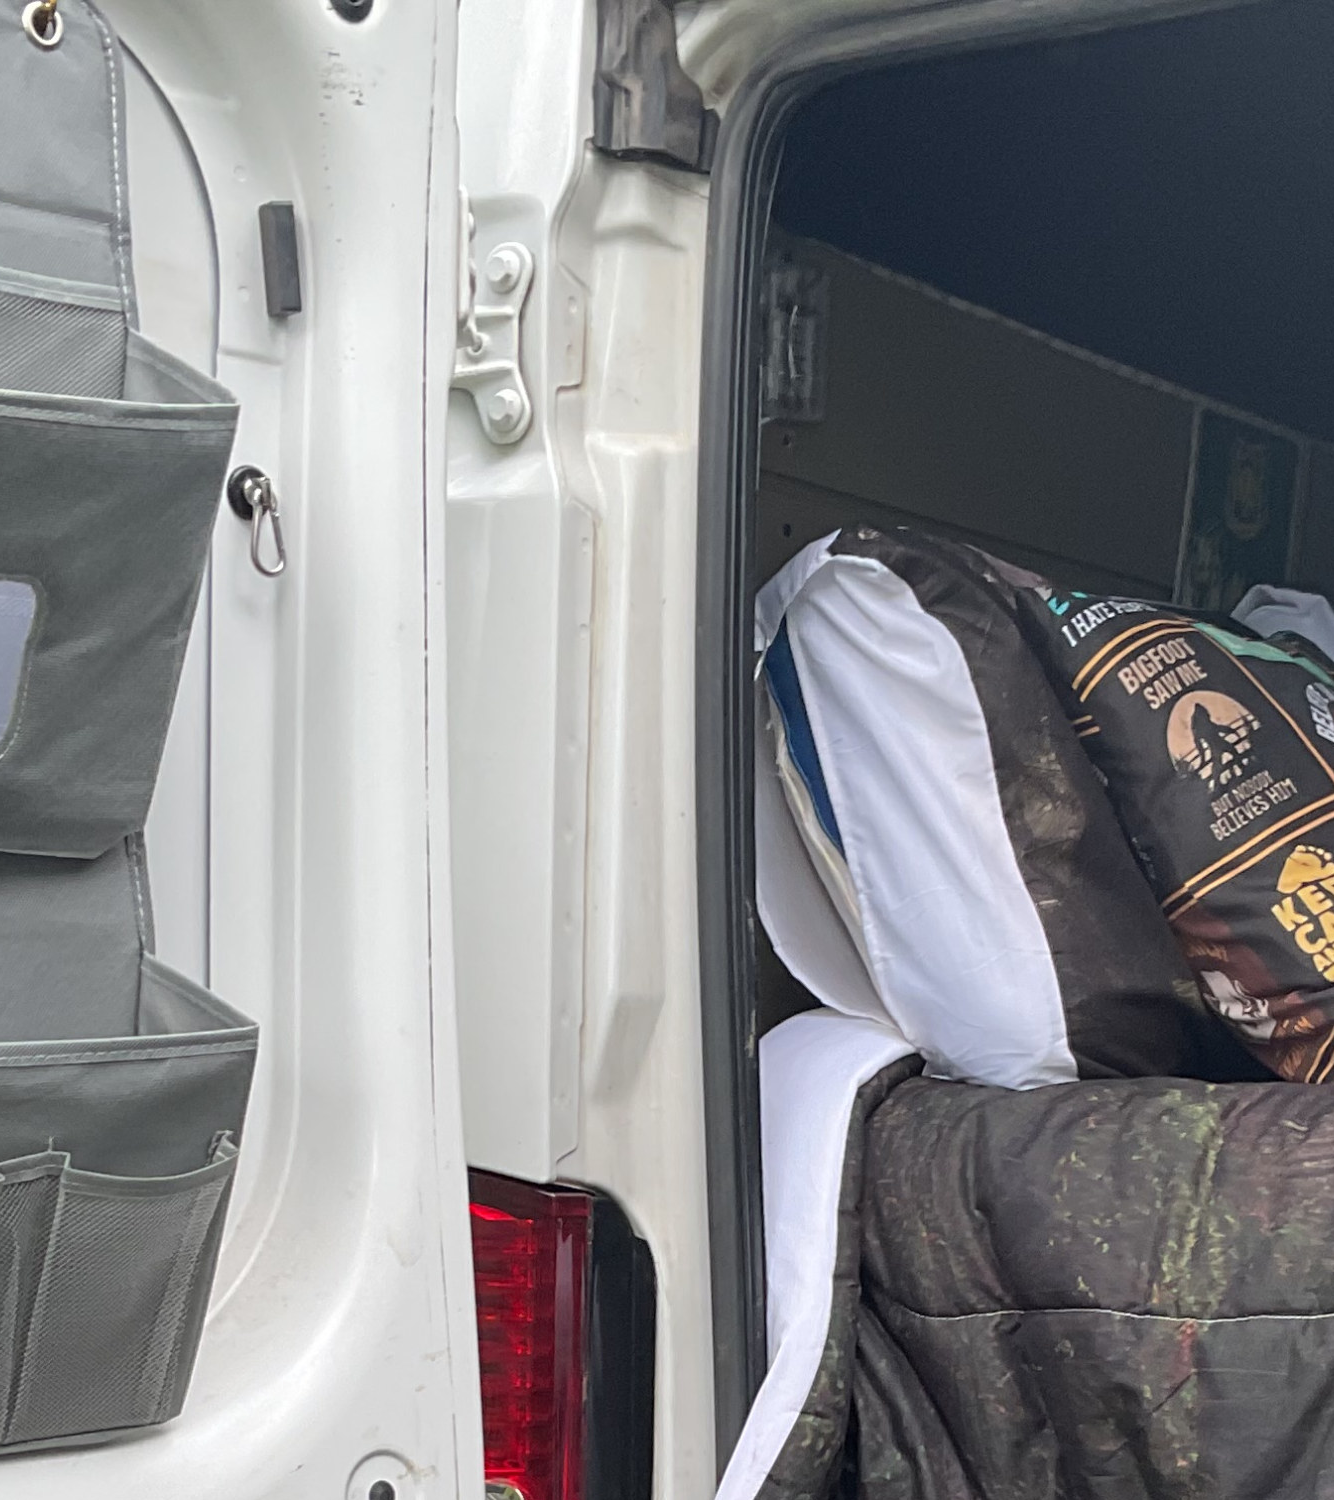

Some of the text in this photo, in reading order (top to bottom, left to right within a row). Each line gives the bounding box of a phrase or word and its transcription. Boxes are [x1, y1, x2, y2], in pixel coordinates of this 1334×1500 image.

[1061, 625, 1078, 647] I
[1070, 602, 1116, 638] HATE
[1117, 637, 1196, 695] BIGFOOT
[1143, 659, 1208, 710] SAW ME
[1209, 777, 1298, 841] BELIEVES HIM
[1210, 770, 1274, 817] BUT NOBODY
